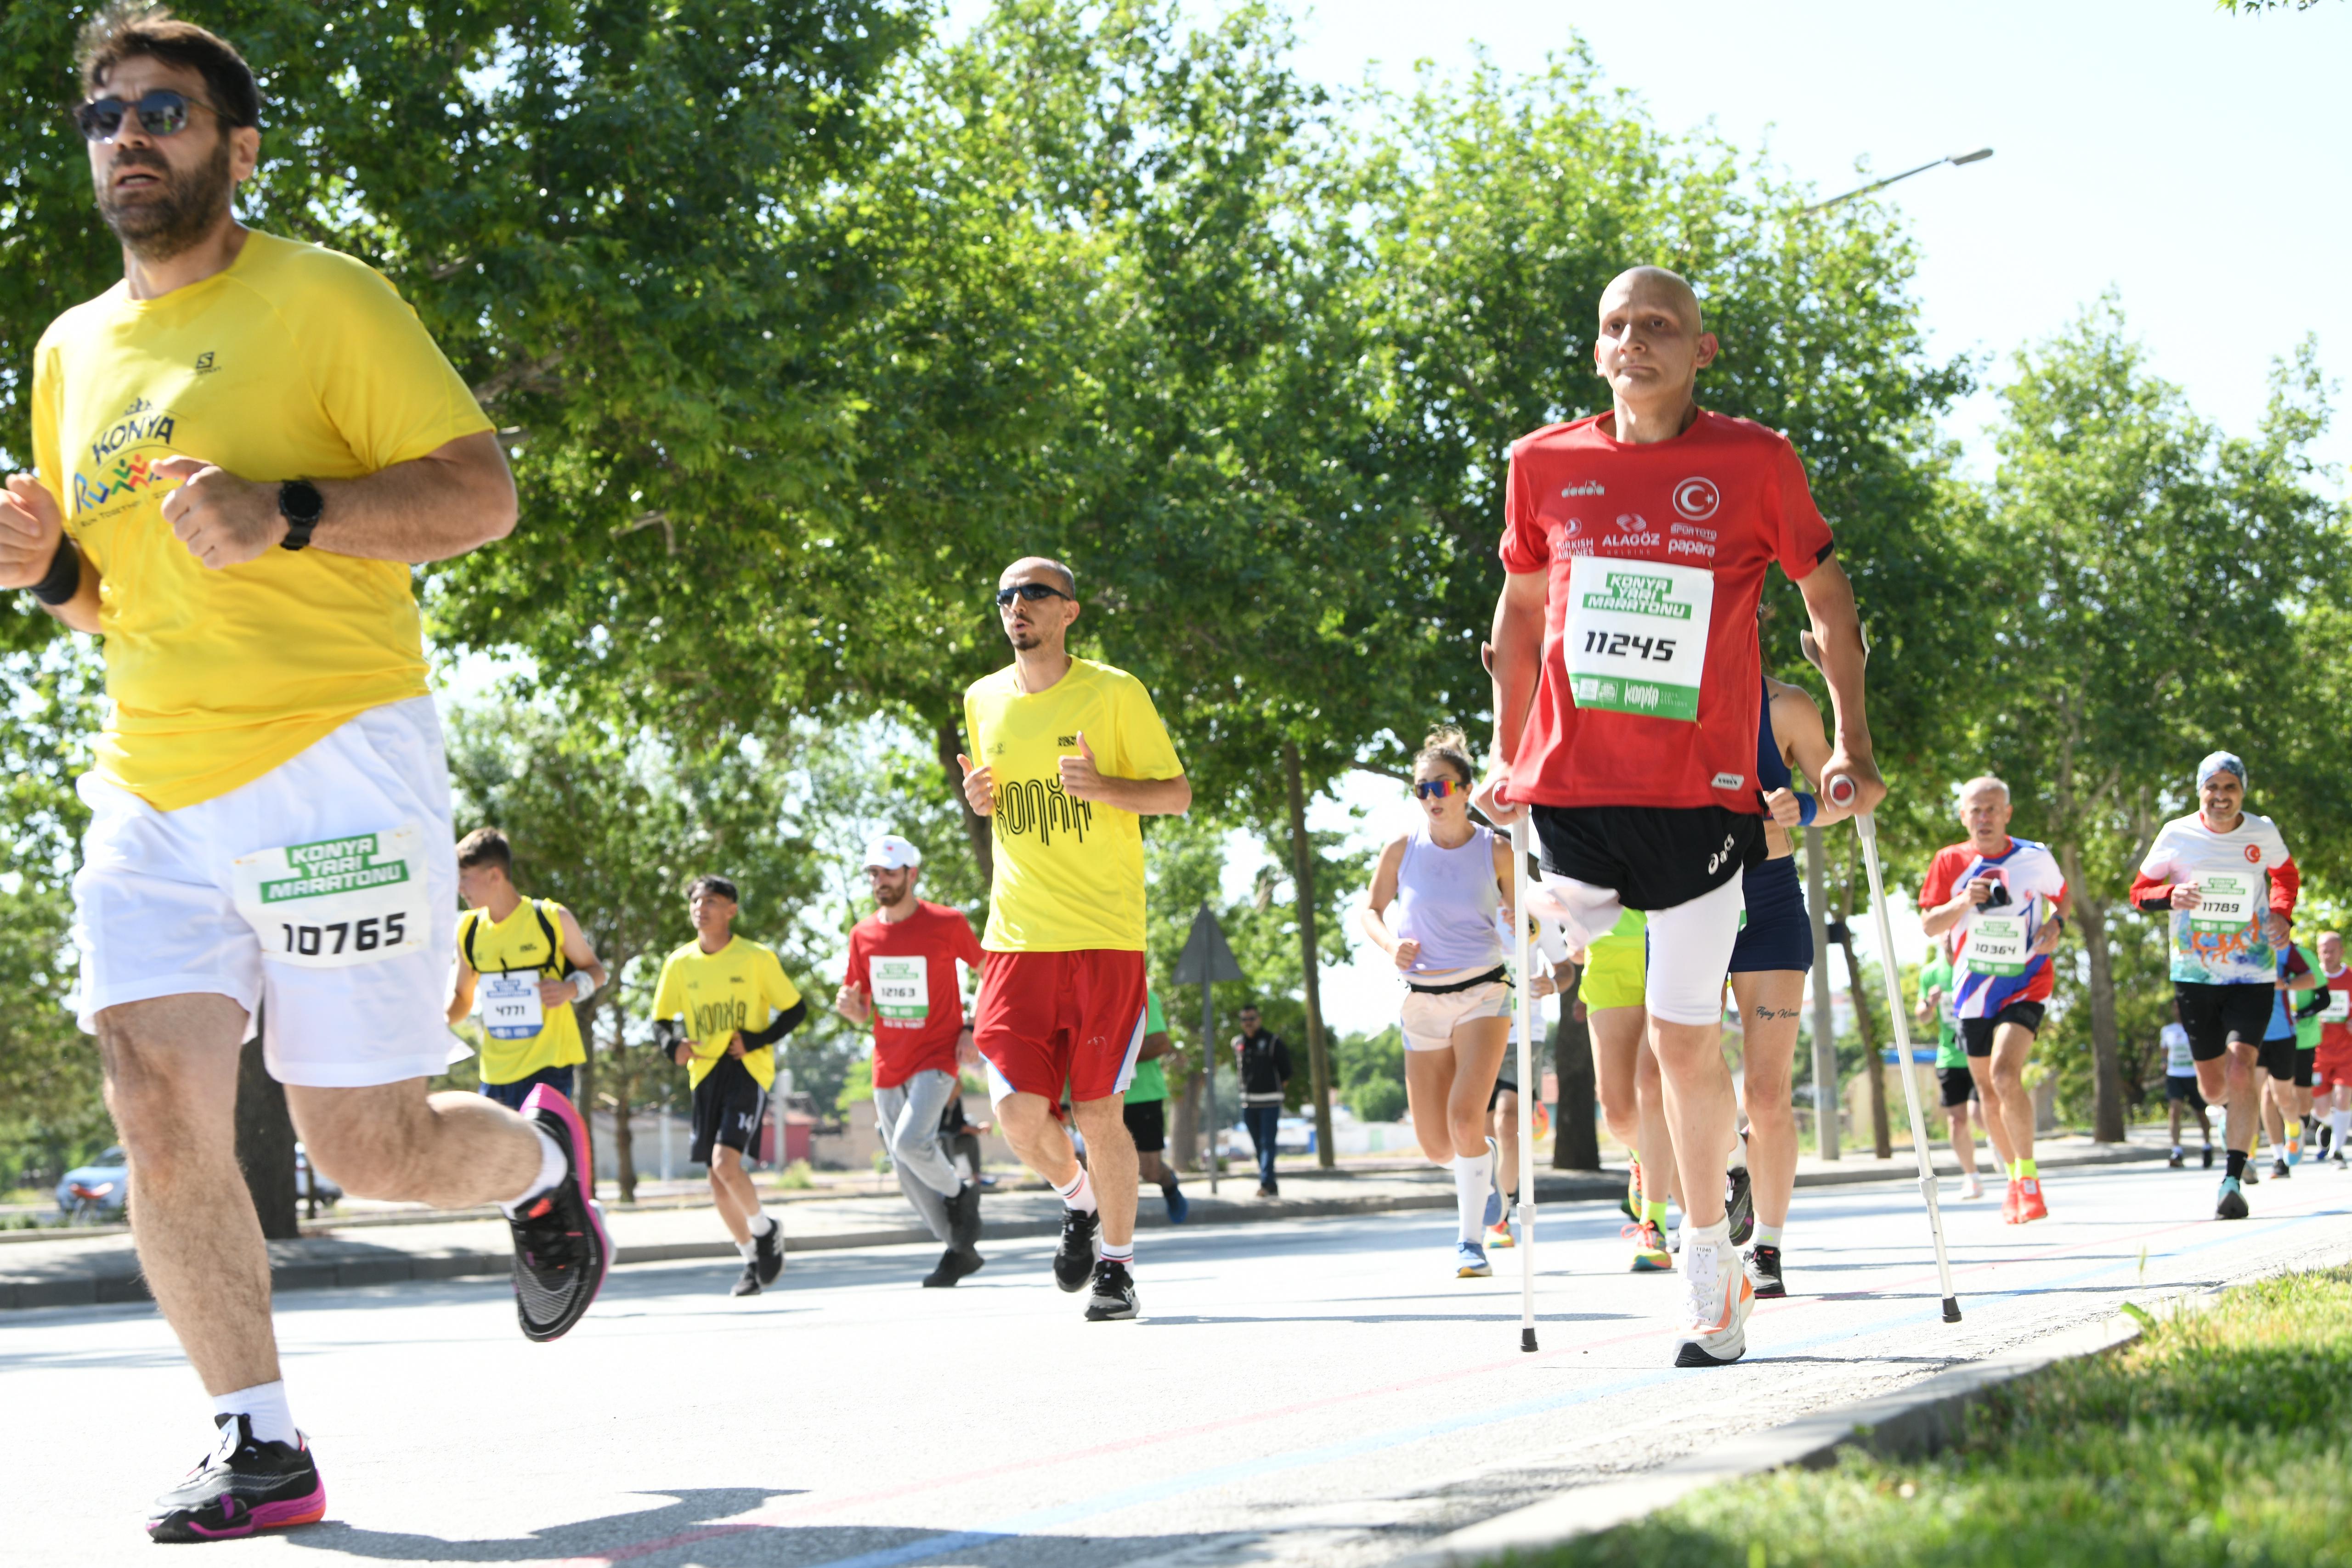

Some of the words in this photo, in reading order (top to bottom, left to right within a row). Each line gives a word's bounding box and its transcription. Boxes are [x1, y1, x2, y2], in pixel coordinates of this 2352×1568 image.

[93, 414, 175, 467] KONYA
[1668, 538, 1715, 559] papara
[1610, 574, 1668, 592] KONYA
[1618, 586, 1657, 602] YARI
[1588, 595, 1685, 618] MARATONU
[1585, 631, 1676, 661] 11245
[292, 837, 373, 865] KONYA
[306, 855, 362, 878] YARI
[268, 864, 401, 899] MARATONU
[2203, 902, 2239, 912] 11789
[282, 912, 406, 955] 10765
[1976, 943, 2016, 954] 10364
[882, 988, 915, 997] 12163
[496, 1005, 525, 1016] 4771
[1756, 1006, 1775, 1021] Flying
